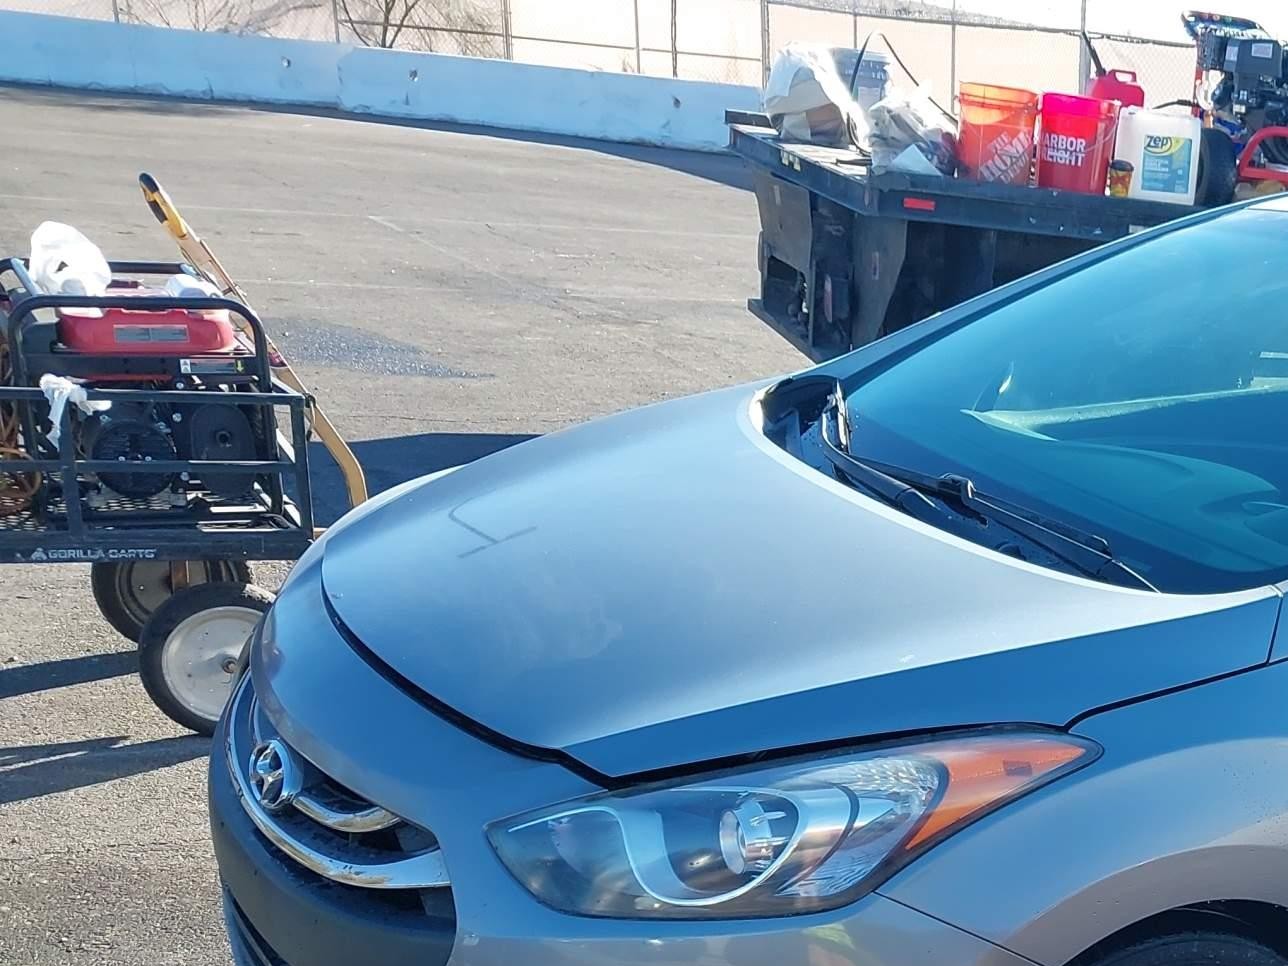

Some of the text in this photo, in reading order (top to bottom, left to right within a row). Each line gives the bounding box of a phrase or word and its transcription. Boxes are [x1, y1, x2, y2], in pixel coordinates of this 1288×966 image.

[1041, 133, 1086, 152] ARBOR
[48, 548, 156, 560] GORILLA CARTS
